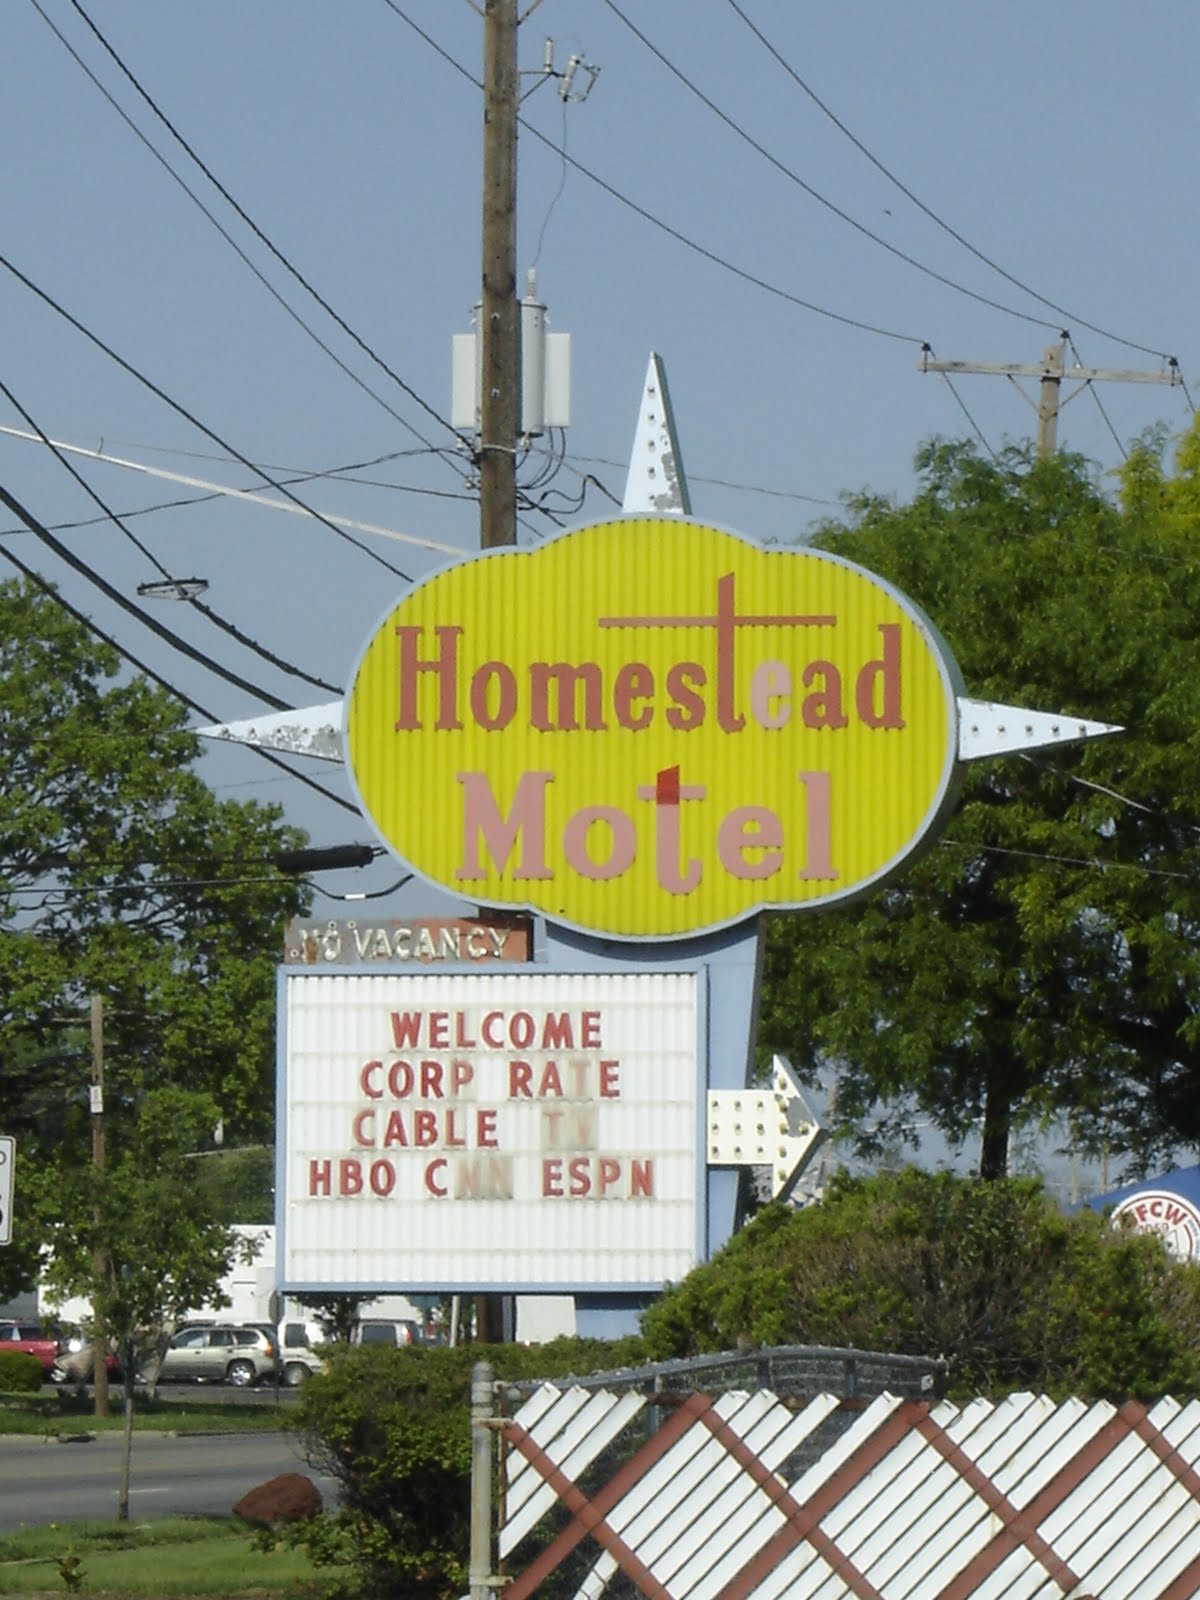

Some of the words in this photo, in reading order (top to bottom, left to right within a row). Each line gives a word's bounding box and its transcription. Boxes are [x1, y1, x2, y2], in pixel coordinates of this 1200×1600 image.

[395, 572, 906, 734] Homestead
[455, 765, 839, 896] Motel
[353, 927, 511, 961] VACANCY
[391, 1011, 602, 1049] WELCOME
[360, 1060, 474, 1099] CORP
[509, 1060, 621, 1098] RATE
[353, 1109, 499, 1148] CABLE
[542, 1109, 592, 1148] TV
[308, 1159, 396, 1196] HBO
[425, 1158, 512, 1197] CNN
[543, 1158, 653, 1196] ESPN
